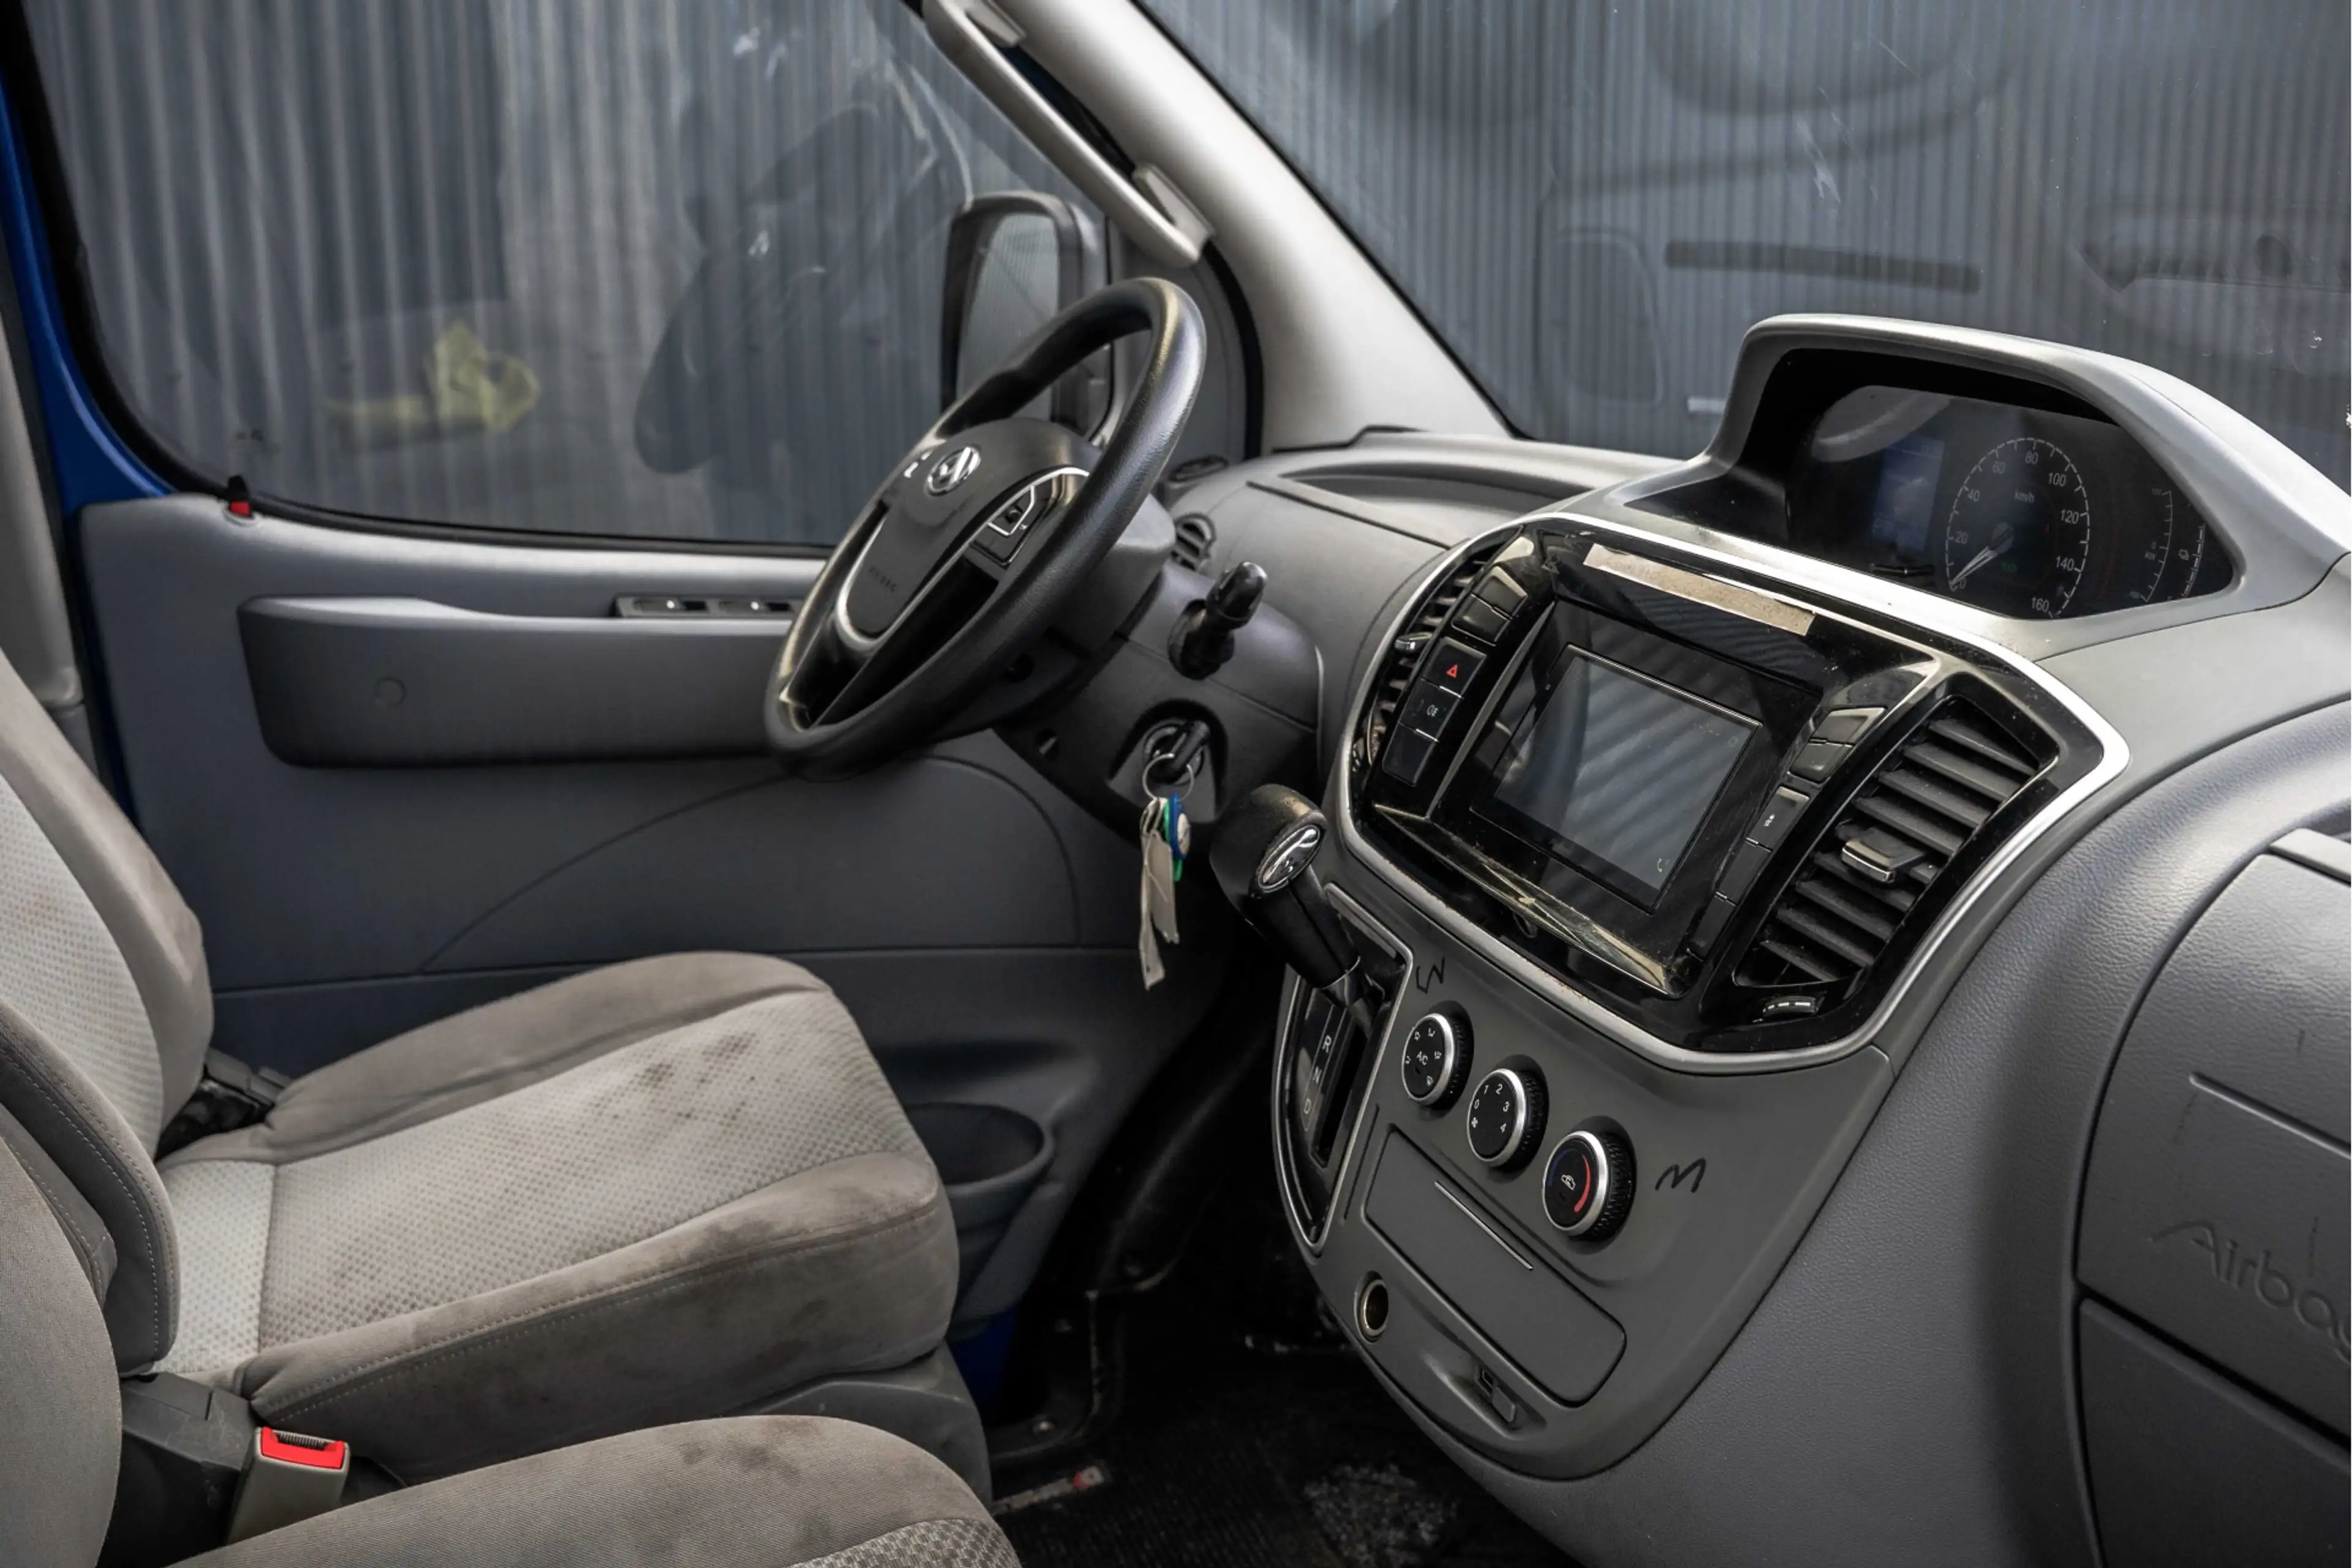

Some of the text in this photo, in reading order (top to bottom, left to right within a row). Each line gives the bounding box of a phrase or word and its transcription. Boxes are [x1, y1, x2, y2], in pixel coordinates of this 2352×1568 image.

[2025, 451, 2038, 465] 80
[1992, 461, 2005, 473] 60
[2048, 472, 2066, 487] 100
[1967, 489, 1980, 502] 40
[2060, 508, 2079, 524] 120
[1954, 530, 1968, 544] 20
[2056, 556, 2075, 571] 140
[2031, 597, 2049, 612] 160
[1321, 1035, 1332, 1053] R
[1313, 1066, 1322, 1084] N
[1483, 1084, 1489, 1095] 1
[1495, 1083, 1503, 1095] 2
[1473, 1098, 1480, 1110] 0
[1502, 1101, 1510, 1112] 3
[1499, 1123, 1507, 1133] 4
